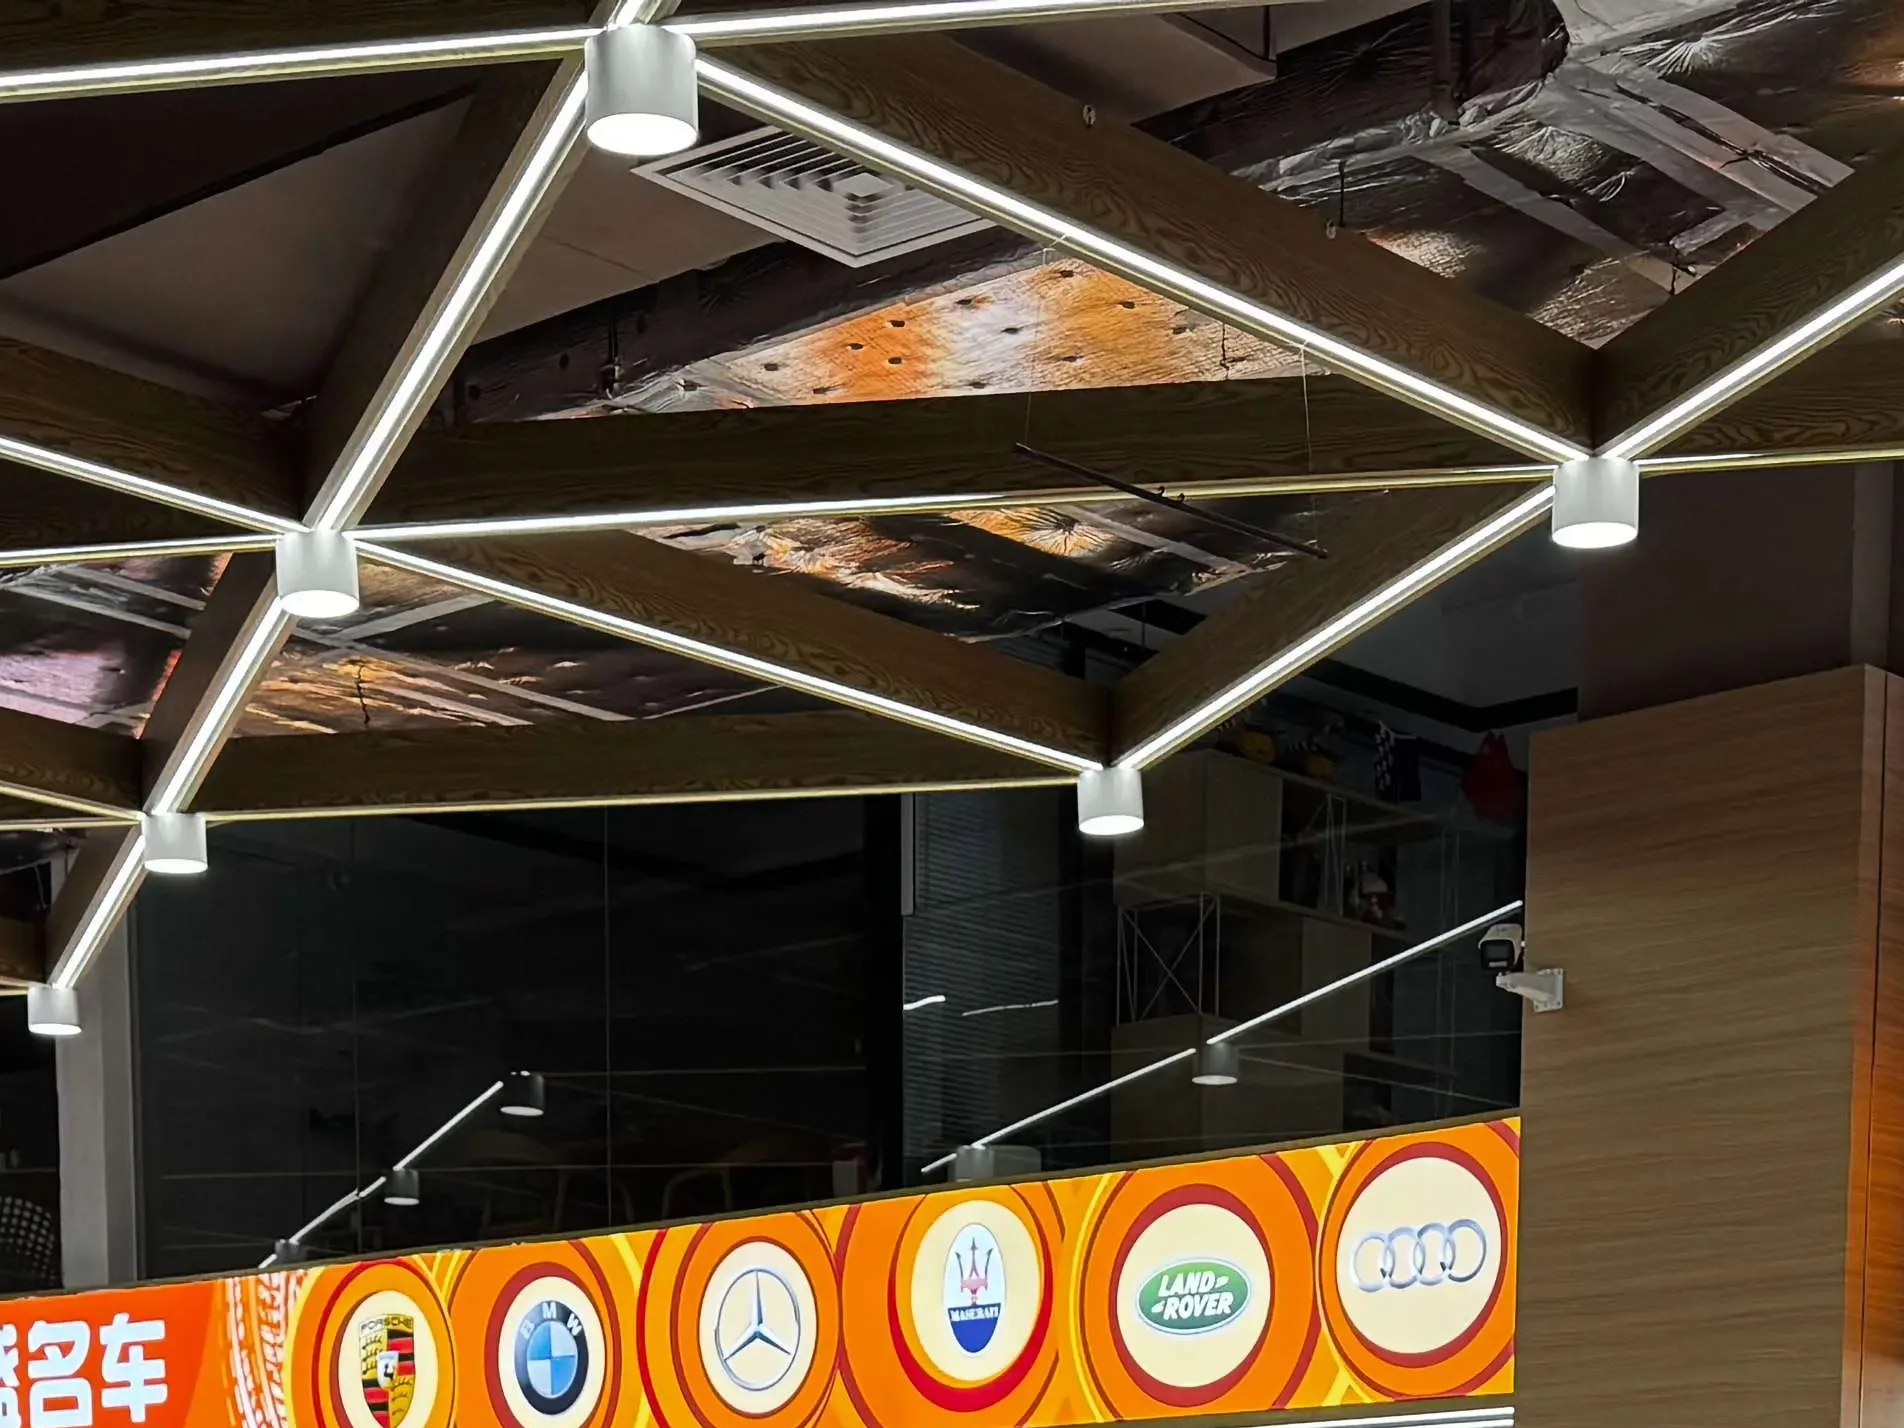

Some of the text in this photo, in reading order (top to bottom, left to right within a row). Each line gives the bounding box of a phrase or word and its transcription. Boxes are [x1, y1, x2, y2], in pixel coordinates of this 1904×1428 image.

[1158, 1270, 1216, 1298] LAND
[521, 1302, 581, 1339] BMW
[1161, 1291, 1235, 1321] ROVER
[360, 1316, 413, 1331] PORSCHE
